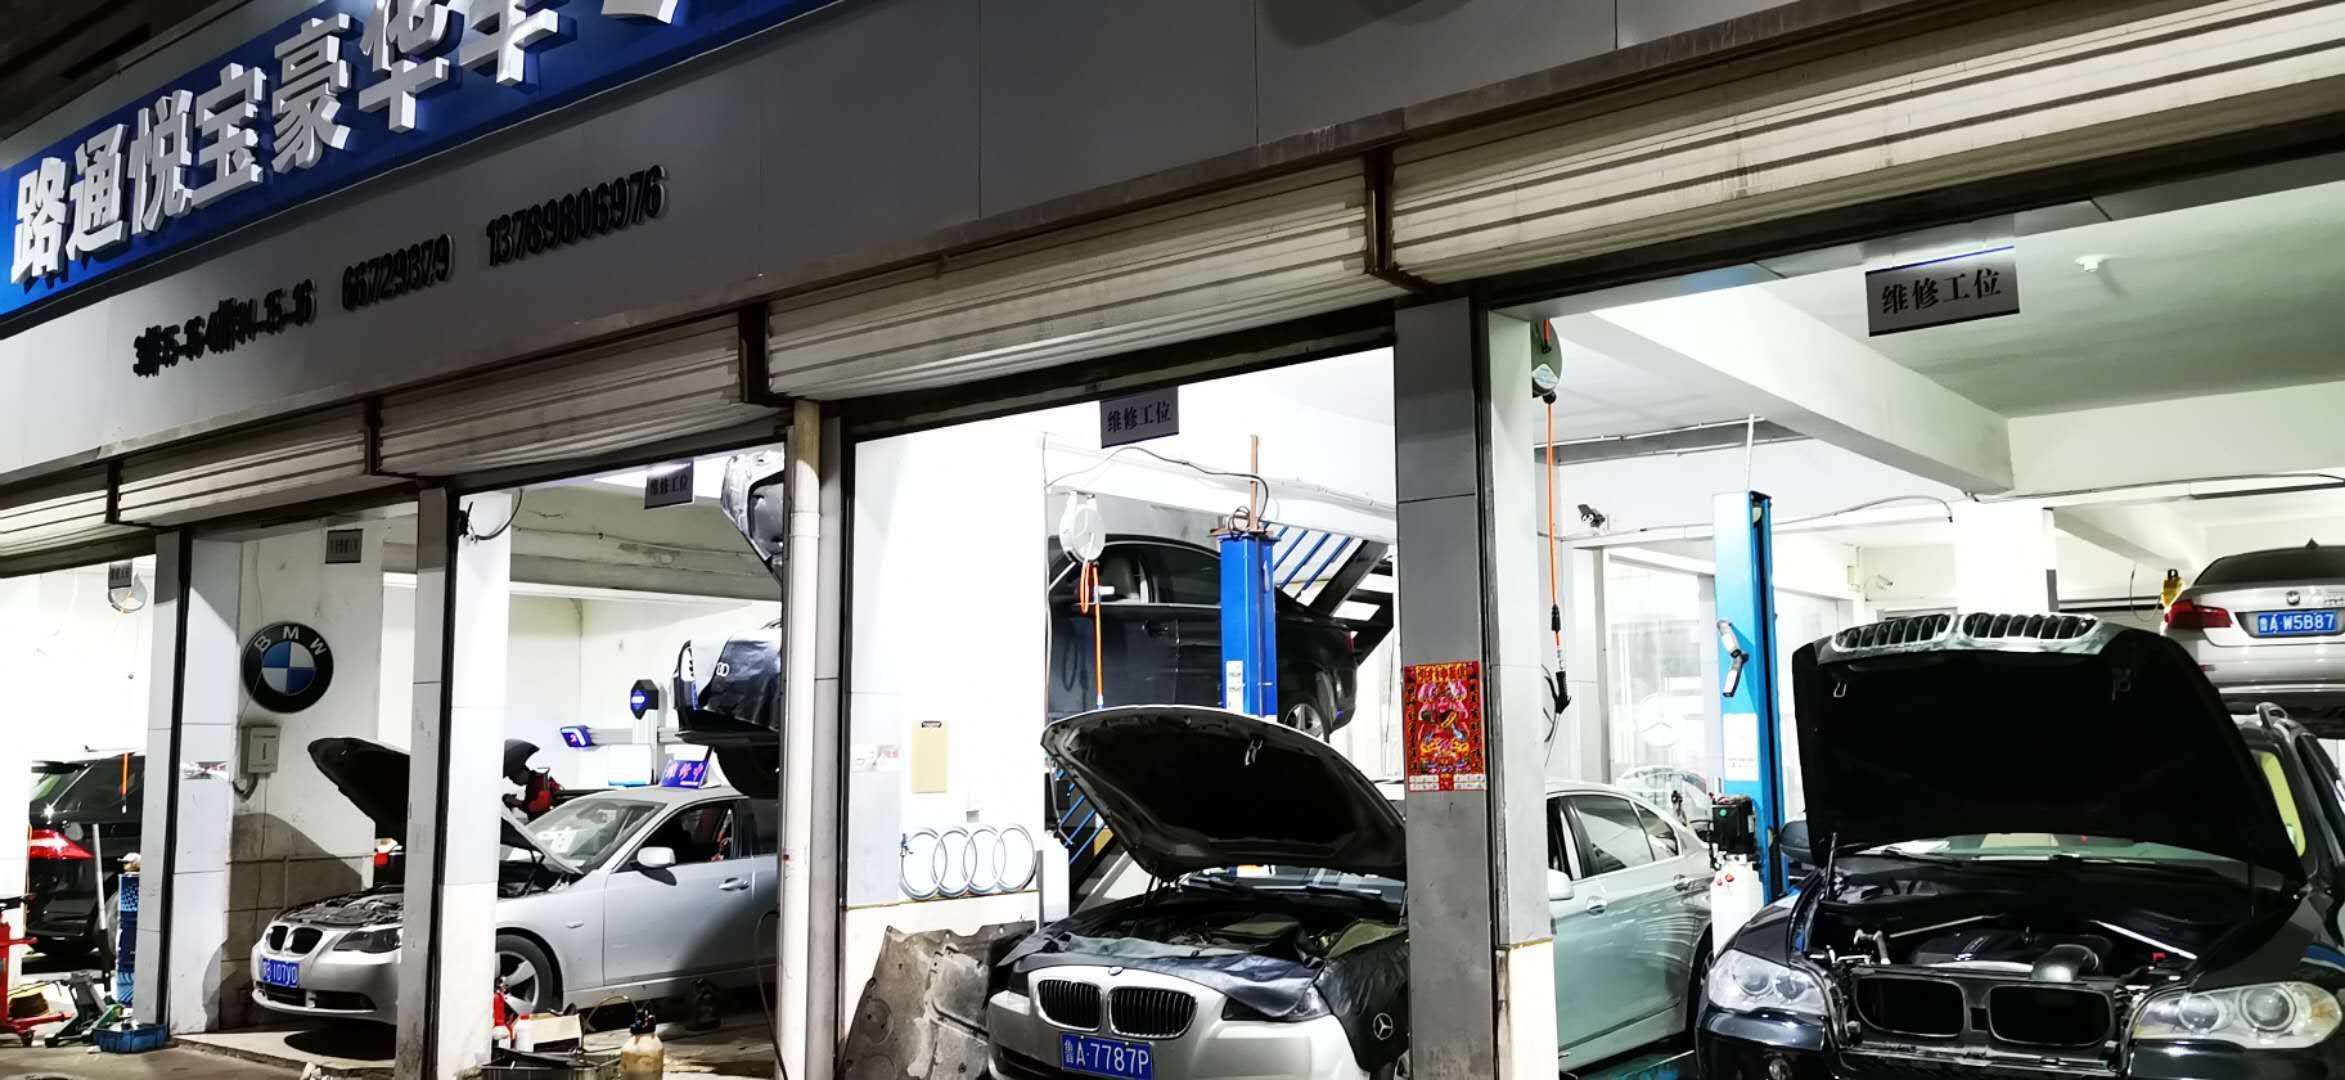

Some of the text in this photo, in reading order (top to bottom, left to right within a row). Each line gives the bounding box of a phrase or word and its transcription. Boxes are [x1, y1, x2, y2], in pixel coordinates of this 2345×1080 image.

[12, 0, 678, 285] 路通悦宝豪华车
[1881, 268, 2003, 314] 维修工位
[1107, 401, 1171, 432] 维修工位
[253, 625, 327, 656] BMW
